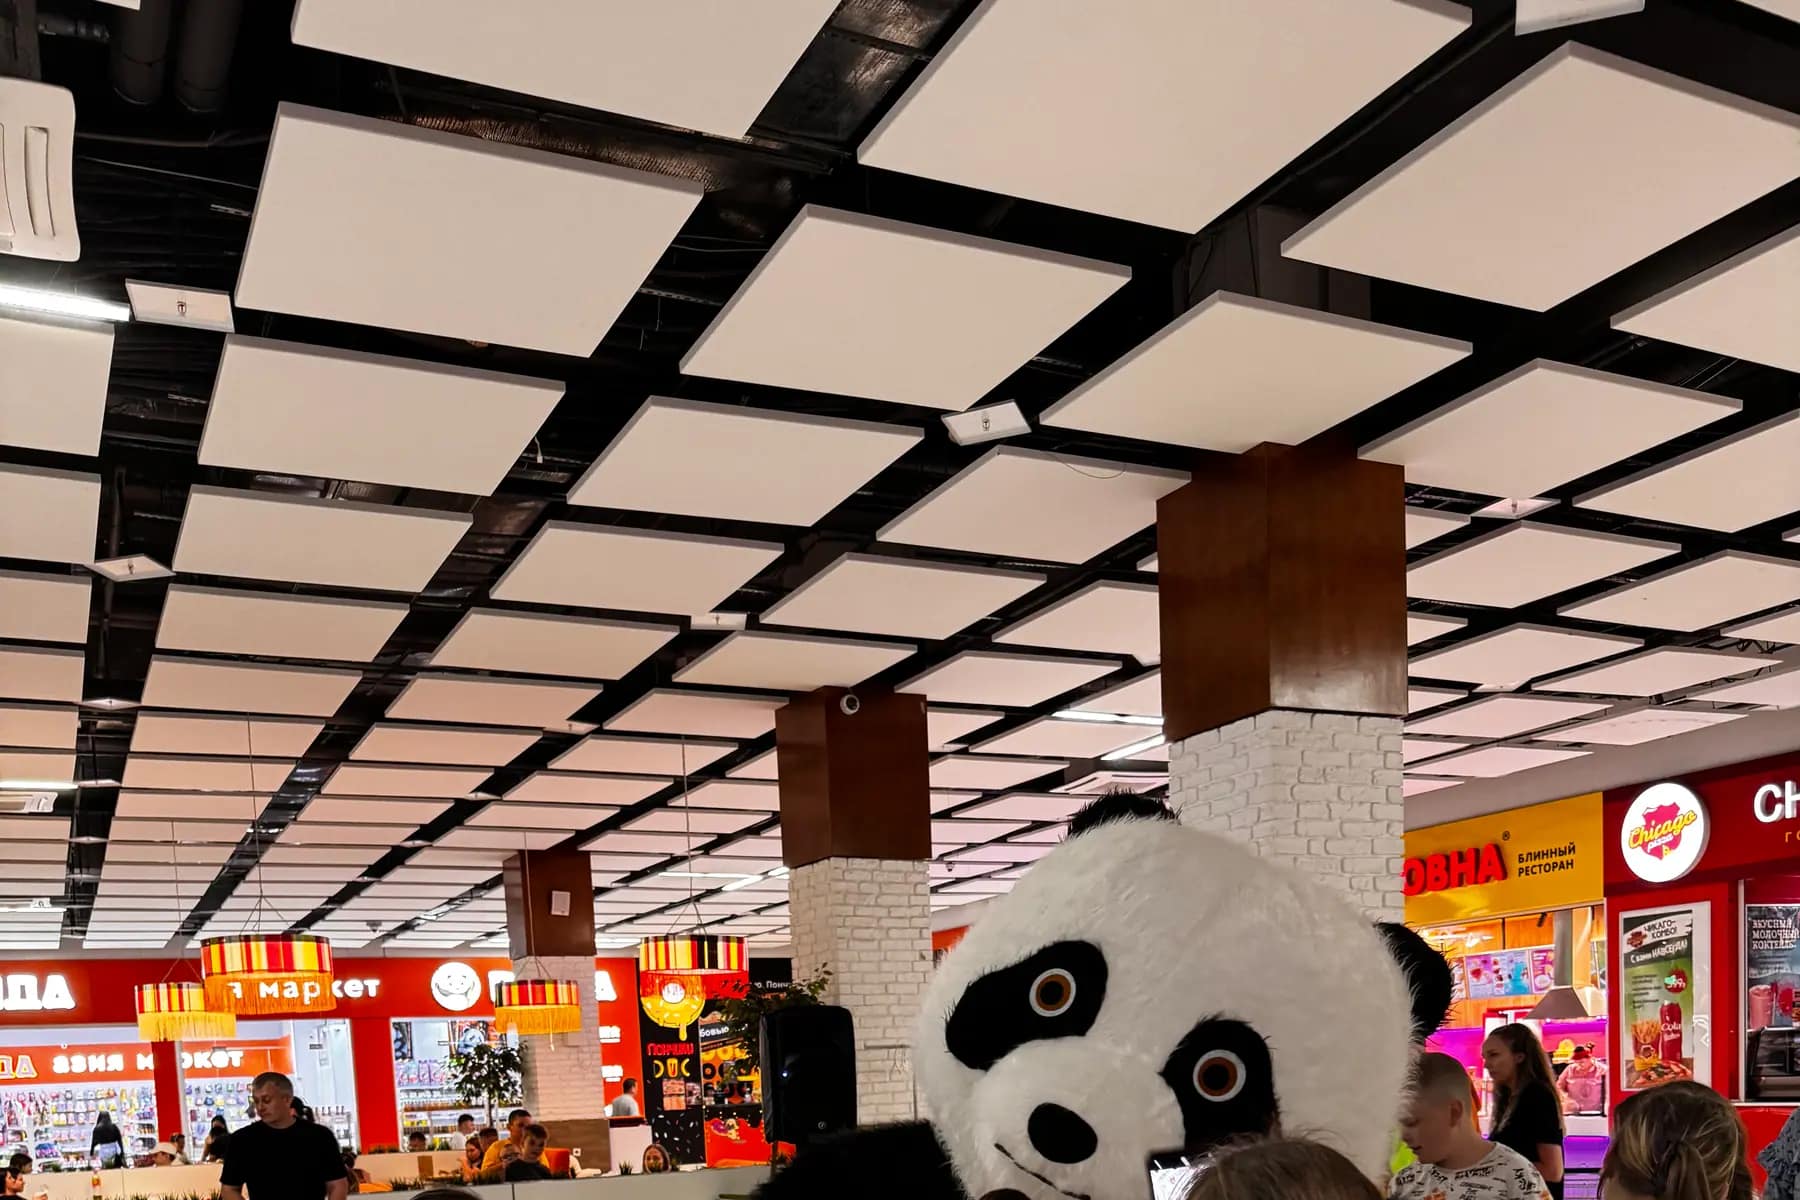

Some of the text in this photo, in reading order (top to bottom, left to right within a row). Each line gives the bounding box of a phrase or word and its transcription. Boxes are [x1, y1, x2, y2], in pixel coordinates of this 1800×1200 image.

[1629, 810, 1697, 849] Chicago
[1518, 842, 1576, 864] БЛИННЫЙ
[1518, 859, 1574, 877] РЕСТОРАН
[0, 974, 76, 1010] ДА
